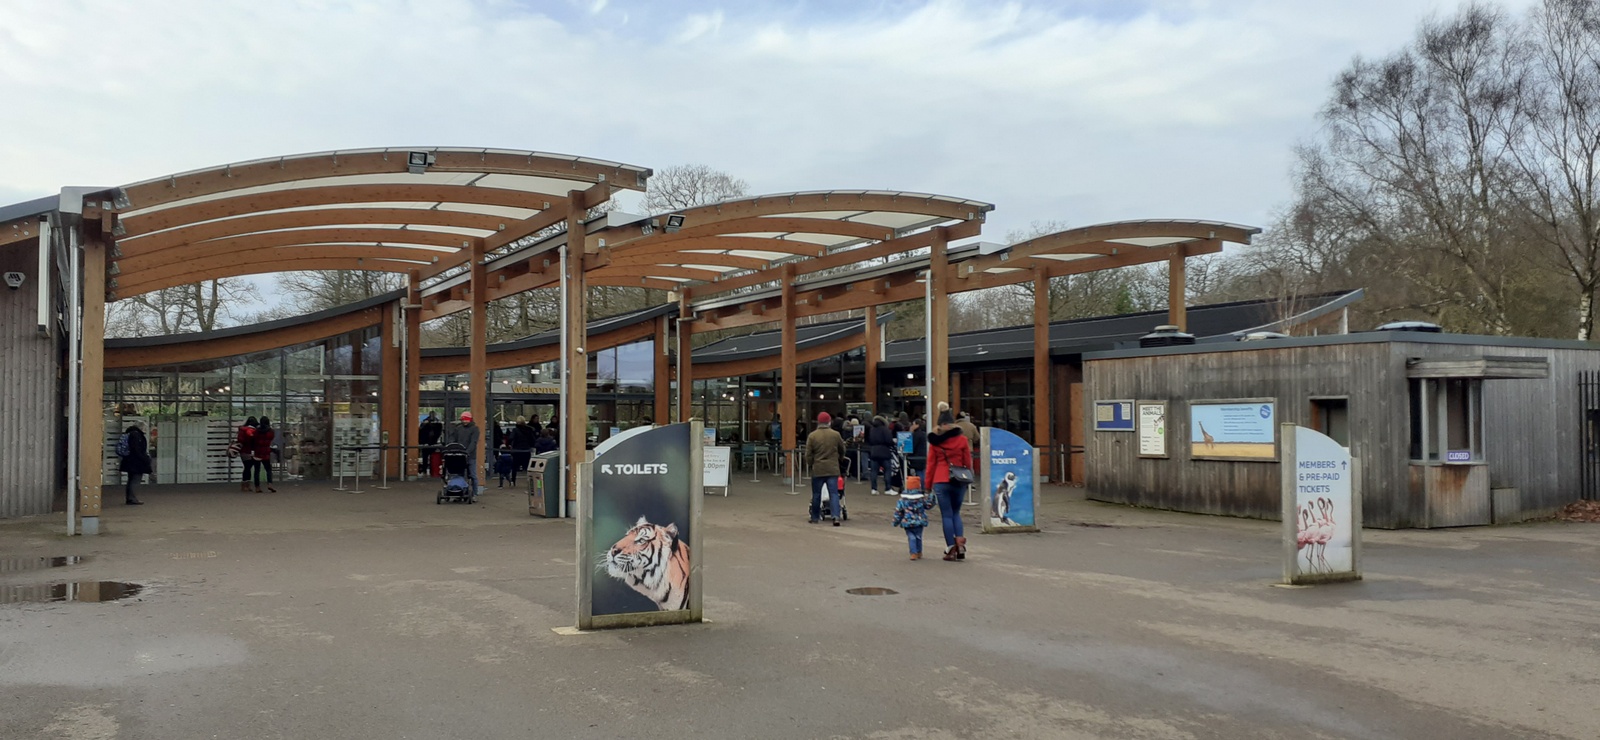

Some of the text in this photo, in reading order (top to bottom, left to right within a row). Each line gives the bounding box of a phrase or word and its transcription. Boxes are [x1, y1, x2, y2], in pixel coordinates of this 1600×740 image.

[511, 384, 560, 395] Welcome
[991, 449, 1005, 457] BUY
[1448, 452, 1470, 460] CLOSED
[991, 457, 1017, 465] TICKETS
[1298, 460, 1337, 469] MEMBERS
[614, 463, 668, 475] TOILETS
[1298, 472, 1340, 481] & PRE-PAID
[1298, 484, 1331, 493] TICKETS
